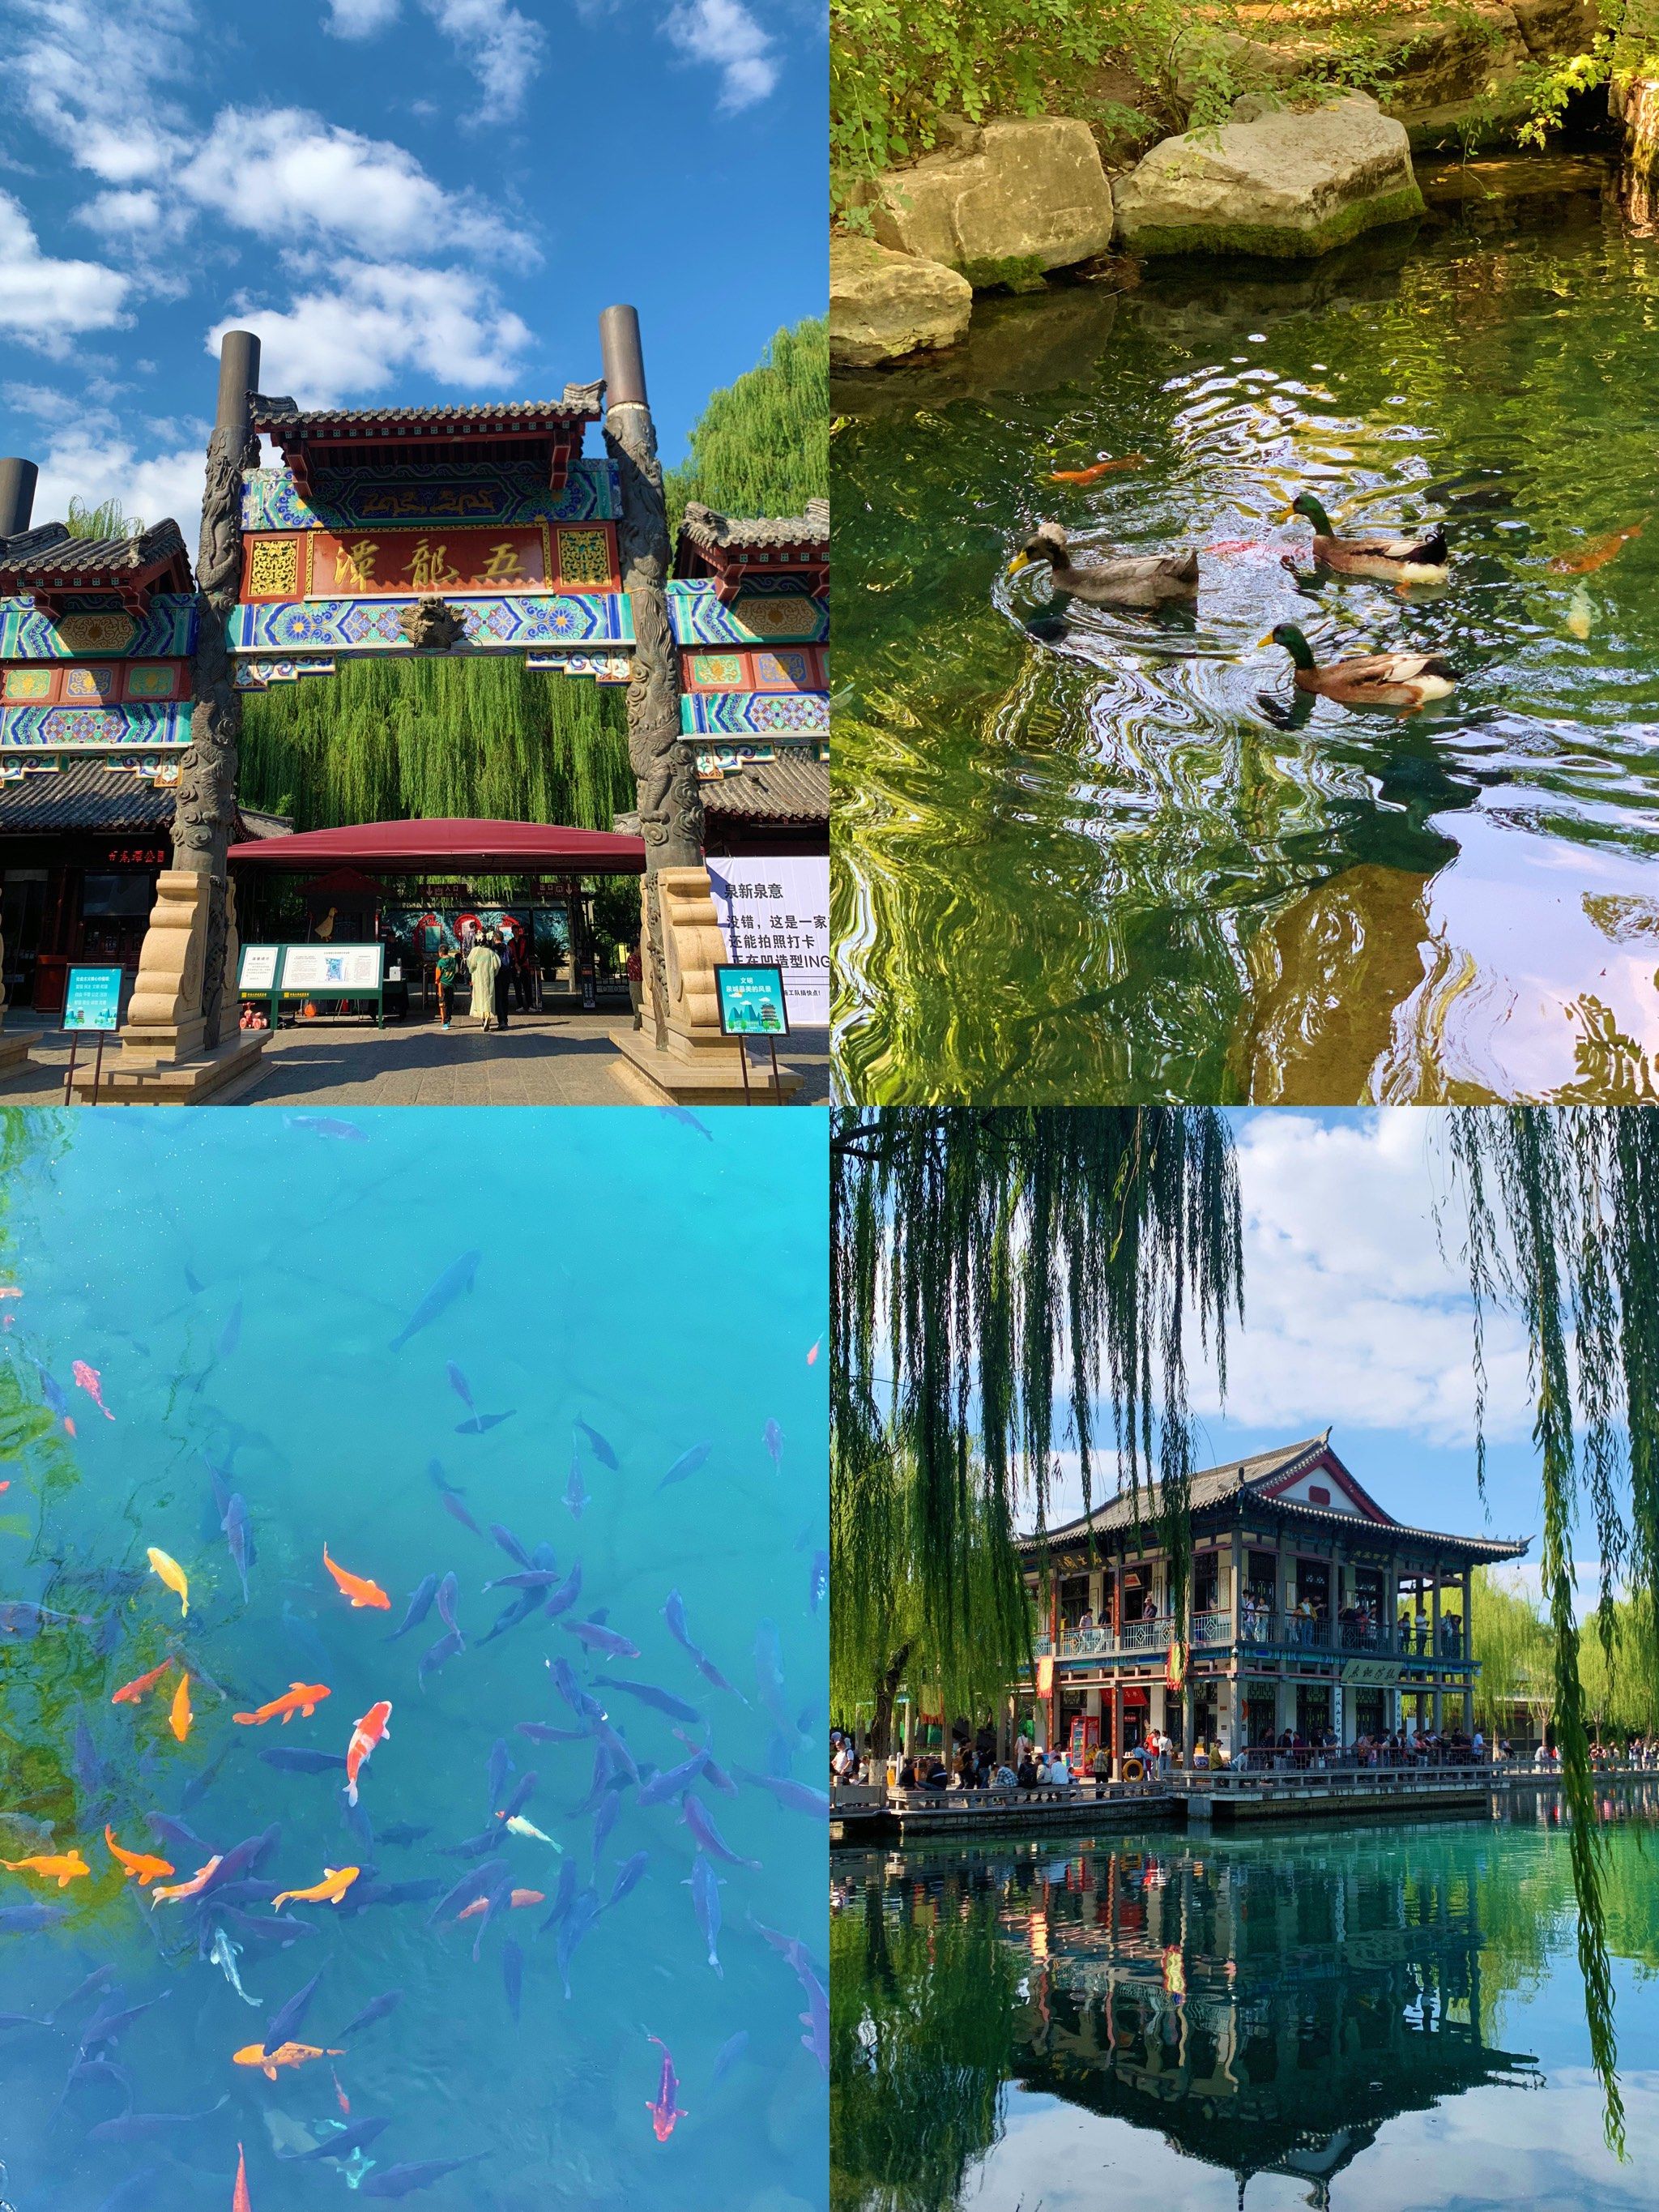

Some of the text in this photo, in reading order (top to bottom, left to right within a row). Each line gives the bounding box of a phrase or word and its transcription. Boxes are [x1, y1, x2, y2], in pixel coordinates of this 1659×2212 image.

[725, 882, 784, 899] 泉新泉意
[726, 915, 830, 929] 没错，这是一家
[728, 934, 815, 949] 还能拍照打卡
[726, 985, 772, 993] 泉城最美的风景
